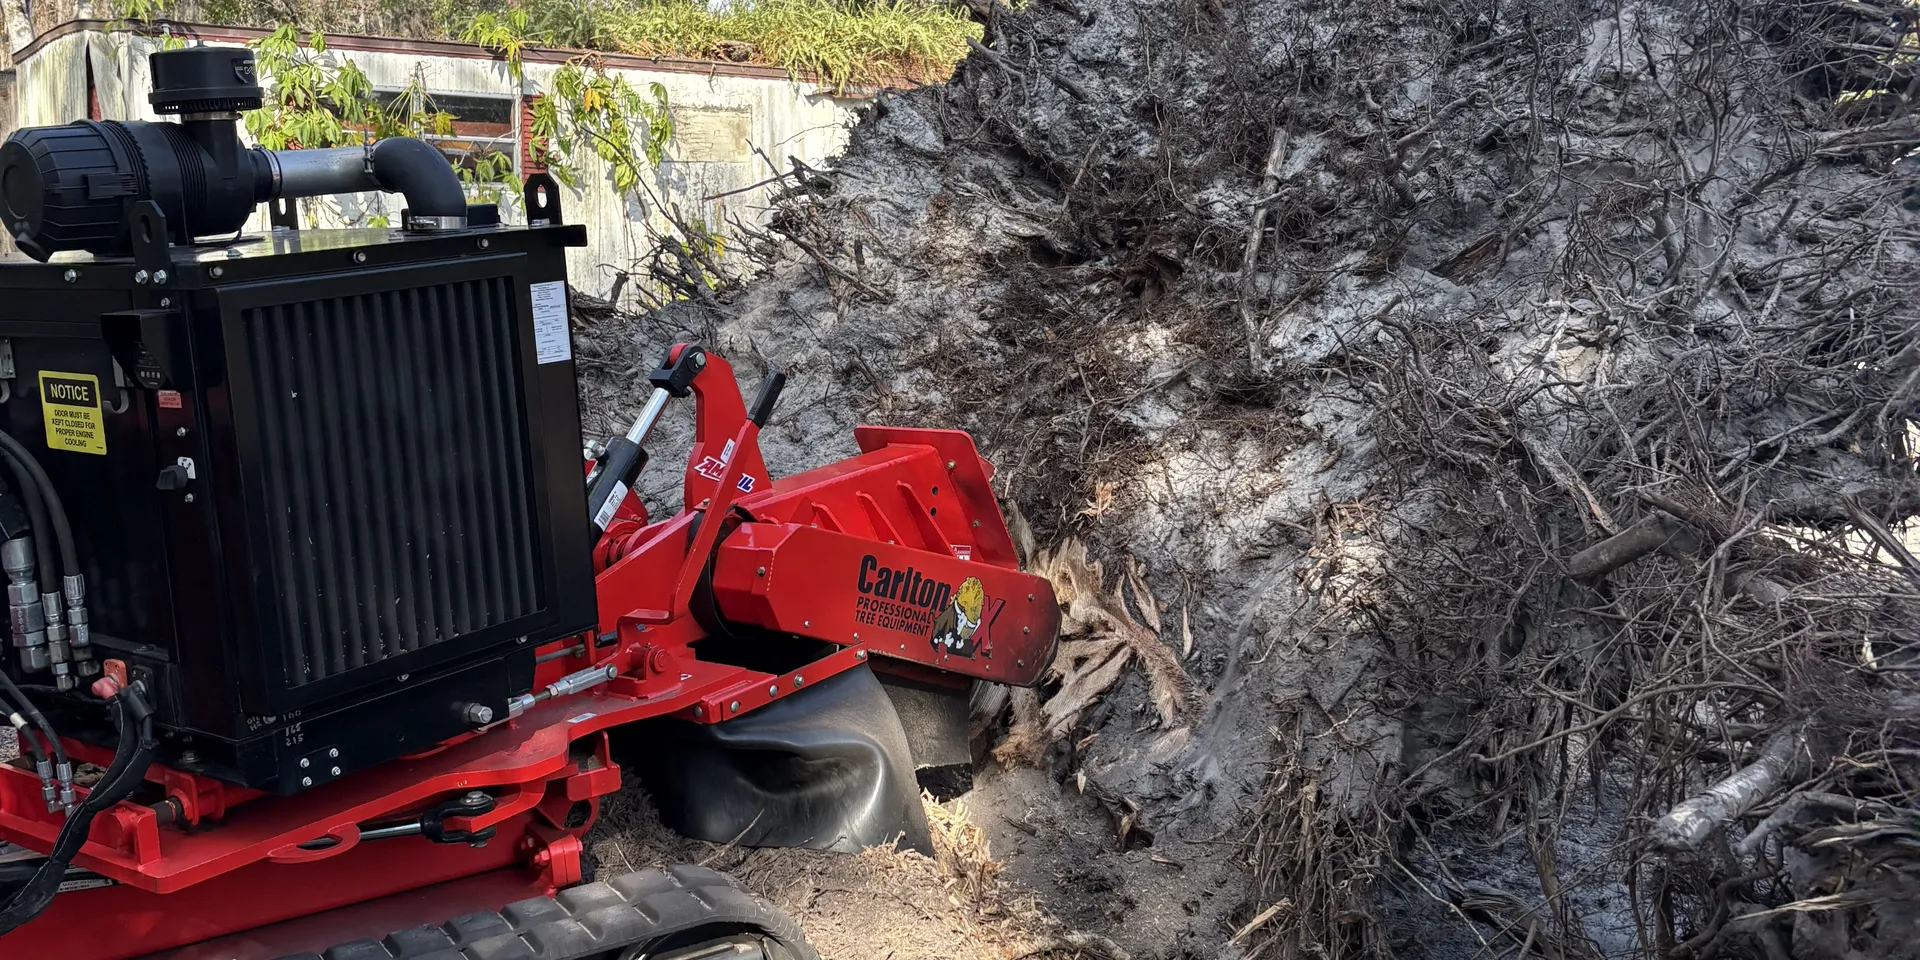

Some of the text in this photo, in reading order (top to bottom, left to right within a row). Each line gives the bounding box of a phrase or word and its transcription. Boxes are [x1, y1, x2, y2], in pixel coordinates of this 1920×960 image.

[50, 383, 89, 401] NOTICE
[54, 409, 90, 420] DOOR MUST BE
[51, 418, 95, 430] KEPT CLOSED FOR
[55, 427, 94, 439] PROPER ENGINE
[65, 438, 87, 447] COOLING
[694, 456, 755, 493] AMIL
[857, 554, 951, 613] Carlton
[856, 596, 932, 624] PROFESSIONAL
[855, 610, 930, 636] TREE EQUIPMENT
[285, 733, 304, 747] 215
